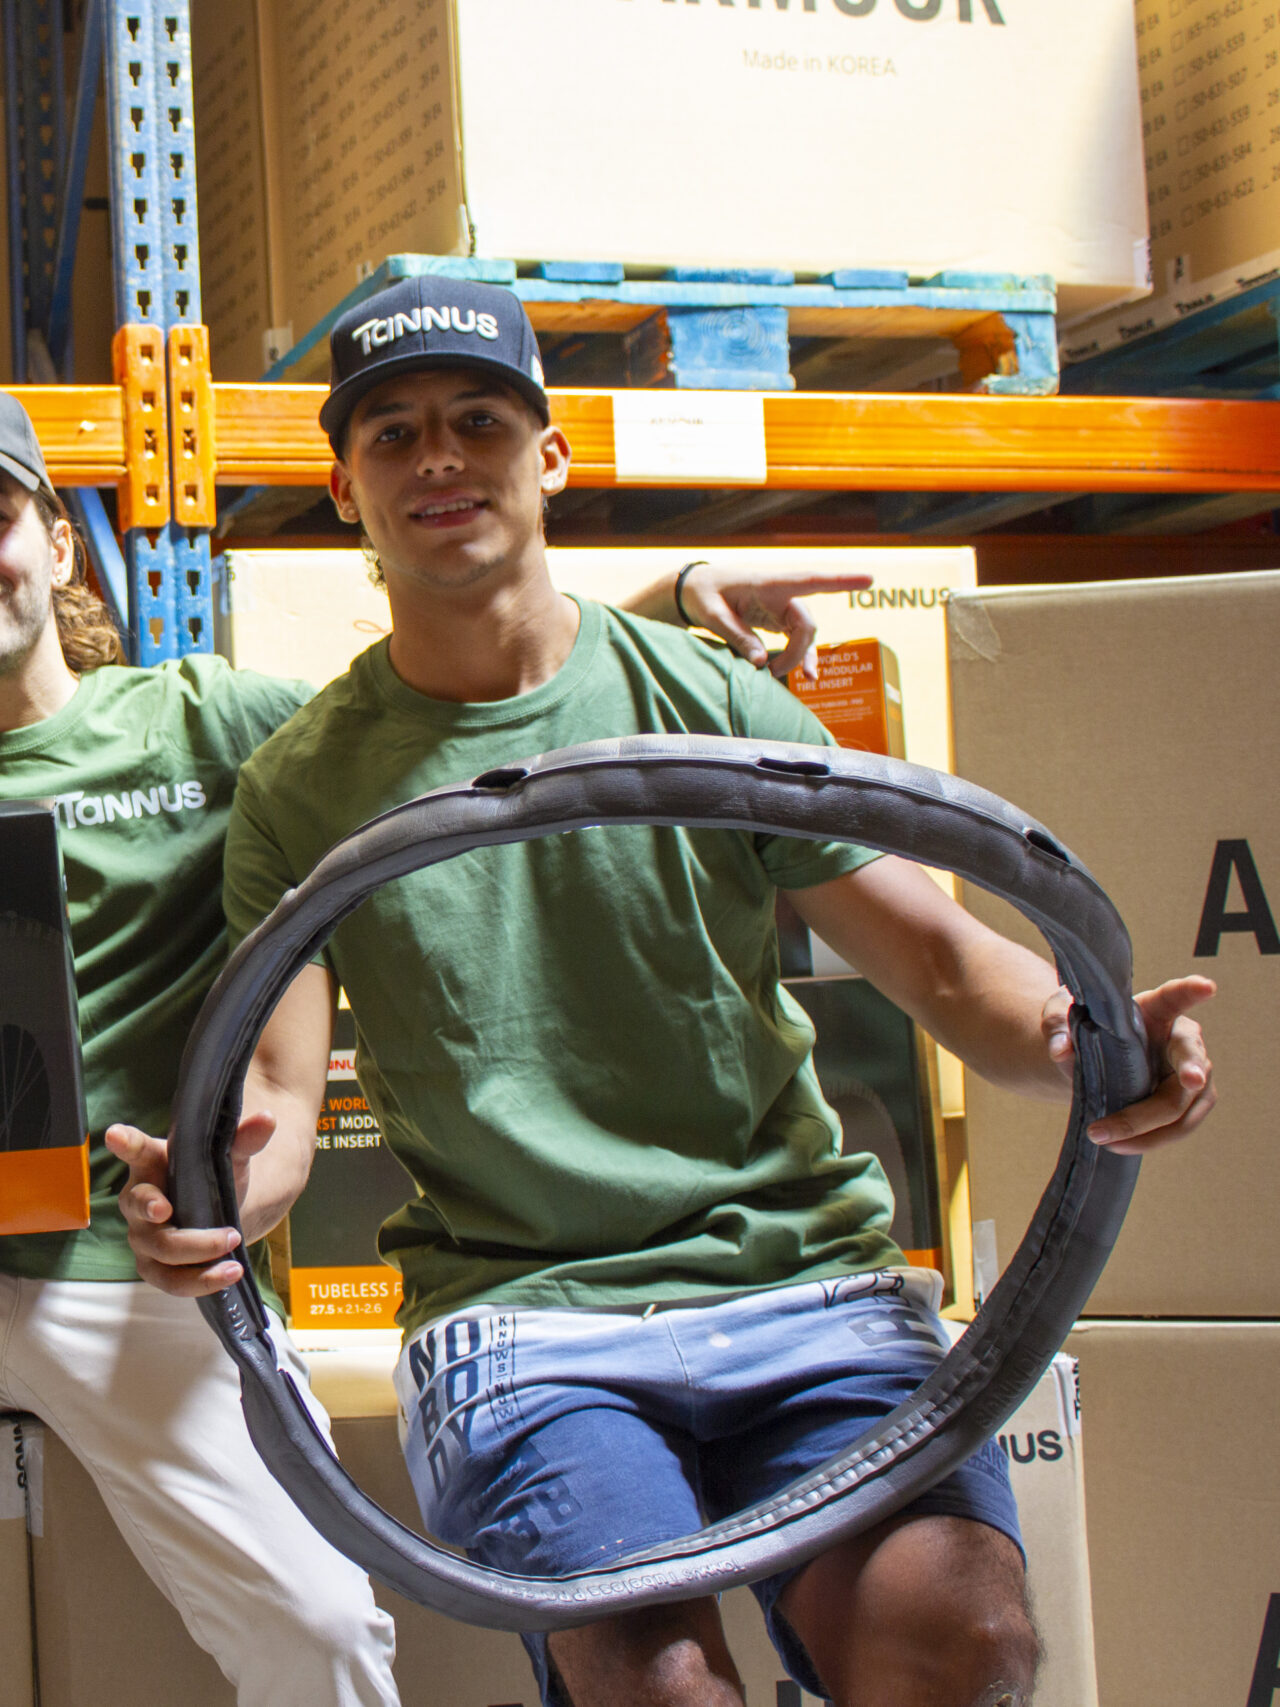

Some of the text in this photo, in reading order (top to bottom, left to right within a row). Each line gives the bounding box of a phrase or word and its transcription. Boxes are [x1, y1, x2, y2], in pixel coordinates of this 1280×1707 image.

[742, 49, 799, 72] Made
[827, 56, 898, 77] KOREA
[333, 1134, 382, 1149] INSERT
[309, 1283, 388, 1299] TUBELESS
[310, 1305, 335, 1315] 27.5
[345, 1304, 382, 1314] 2.1-2.6
